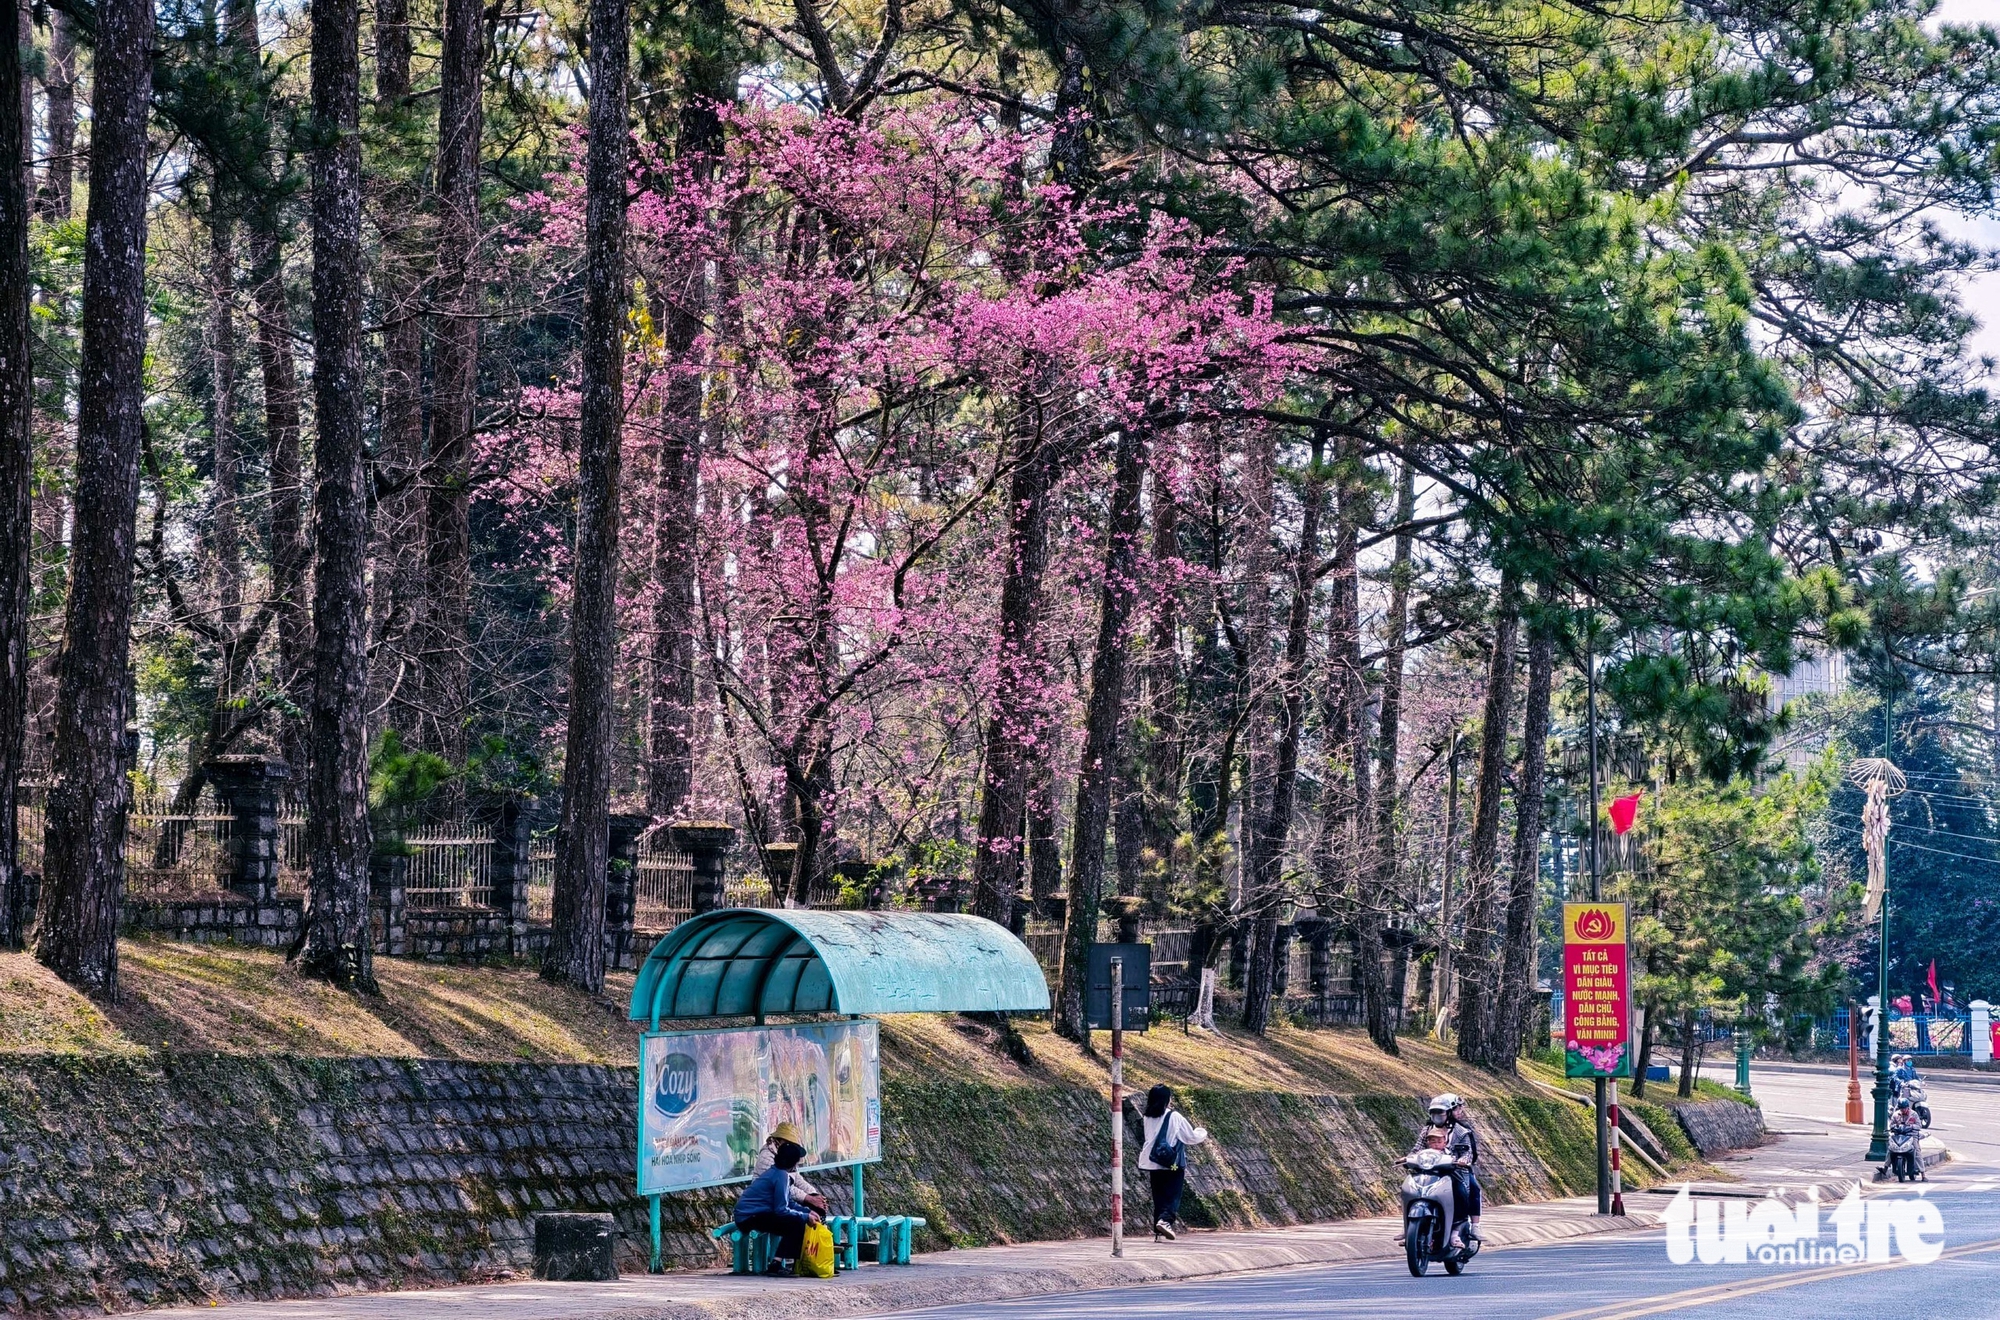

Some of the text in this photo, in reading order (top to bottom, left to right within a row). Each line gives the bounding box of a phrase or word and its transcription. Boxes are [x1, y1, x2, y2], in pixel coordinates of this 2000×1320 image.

[1582, 949, 1608, 961] TẤT CẢ
[1573, 963, 1618, 976] VÌ MỤC TIÊU
[1577, 976, 1615, 988] DÂN GIÀU,
[1572, 989, 1620, 1002] NƯỚC MẠNH,
[1578, 1001, 1614, 1014] DÂN CHỦ,
[1573, 1013, 1620, 1027] CÔNG BẰNG,
[1576, 1028, 1617, 1039] VĂN MINH!
[660, 1064, 693, 1103] Cozy
